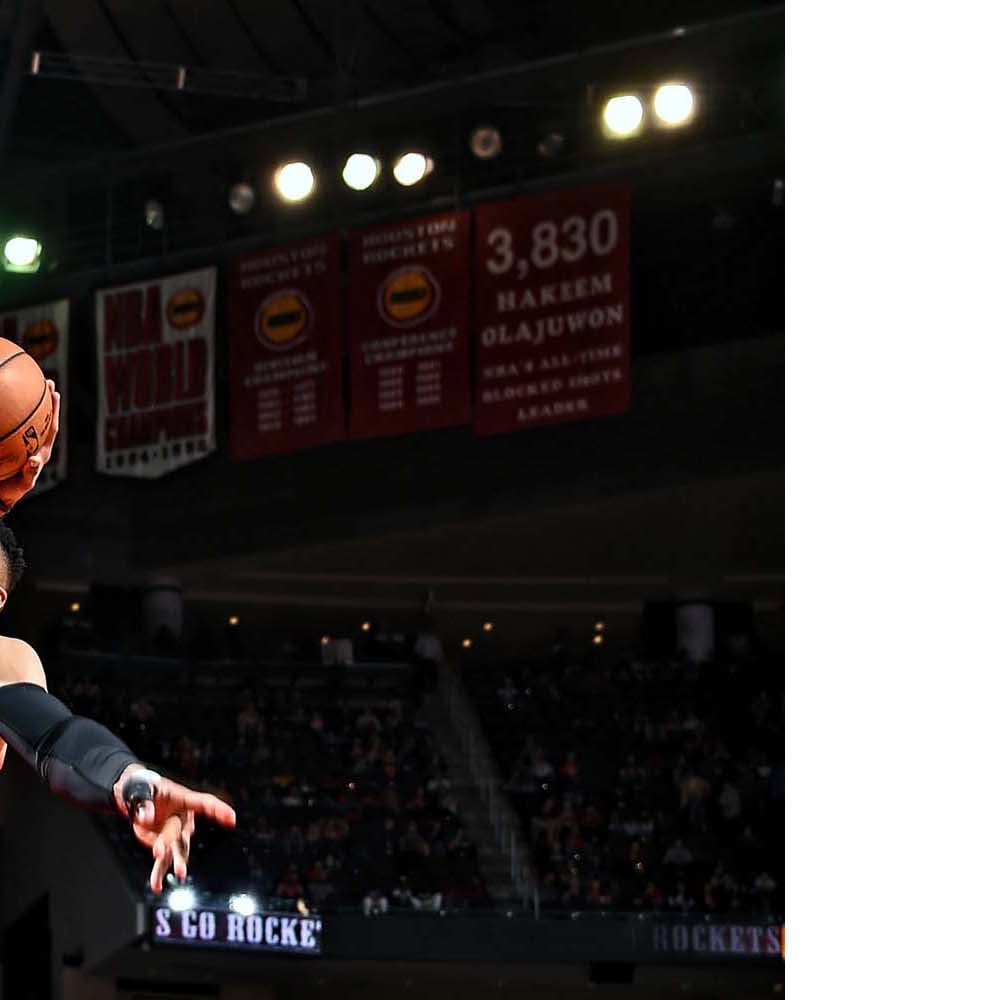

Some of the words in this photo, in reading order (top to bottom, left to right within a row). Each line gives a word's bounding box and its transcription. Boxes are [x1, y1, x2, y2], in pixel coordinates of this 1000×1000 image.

[486, 207, 619, 280] 3,830
[496, 272, 614, 312] HAKEEM
[481, 303, 624, 348] OLAJUWON
[155, 908, 171, 937] S
[181, 910, 216, 940] GO
[652, 924, 781, 955] ROCKETS
